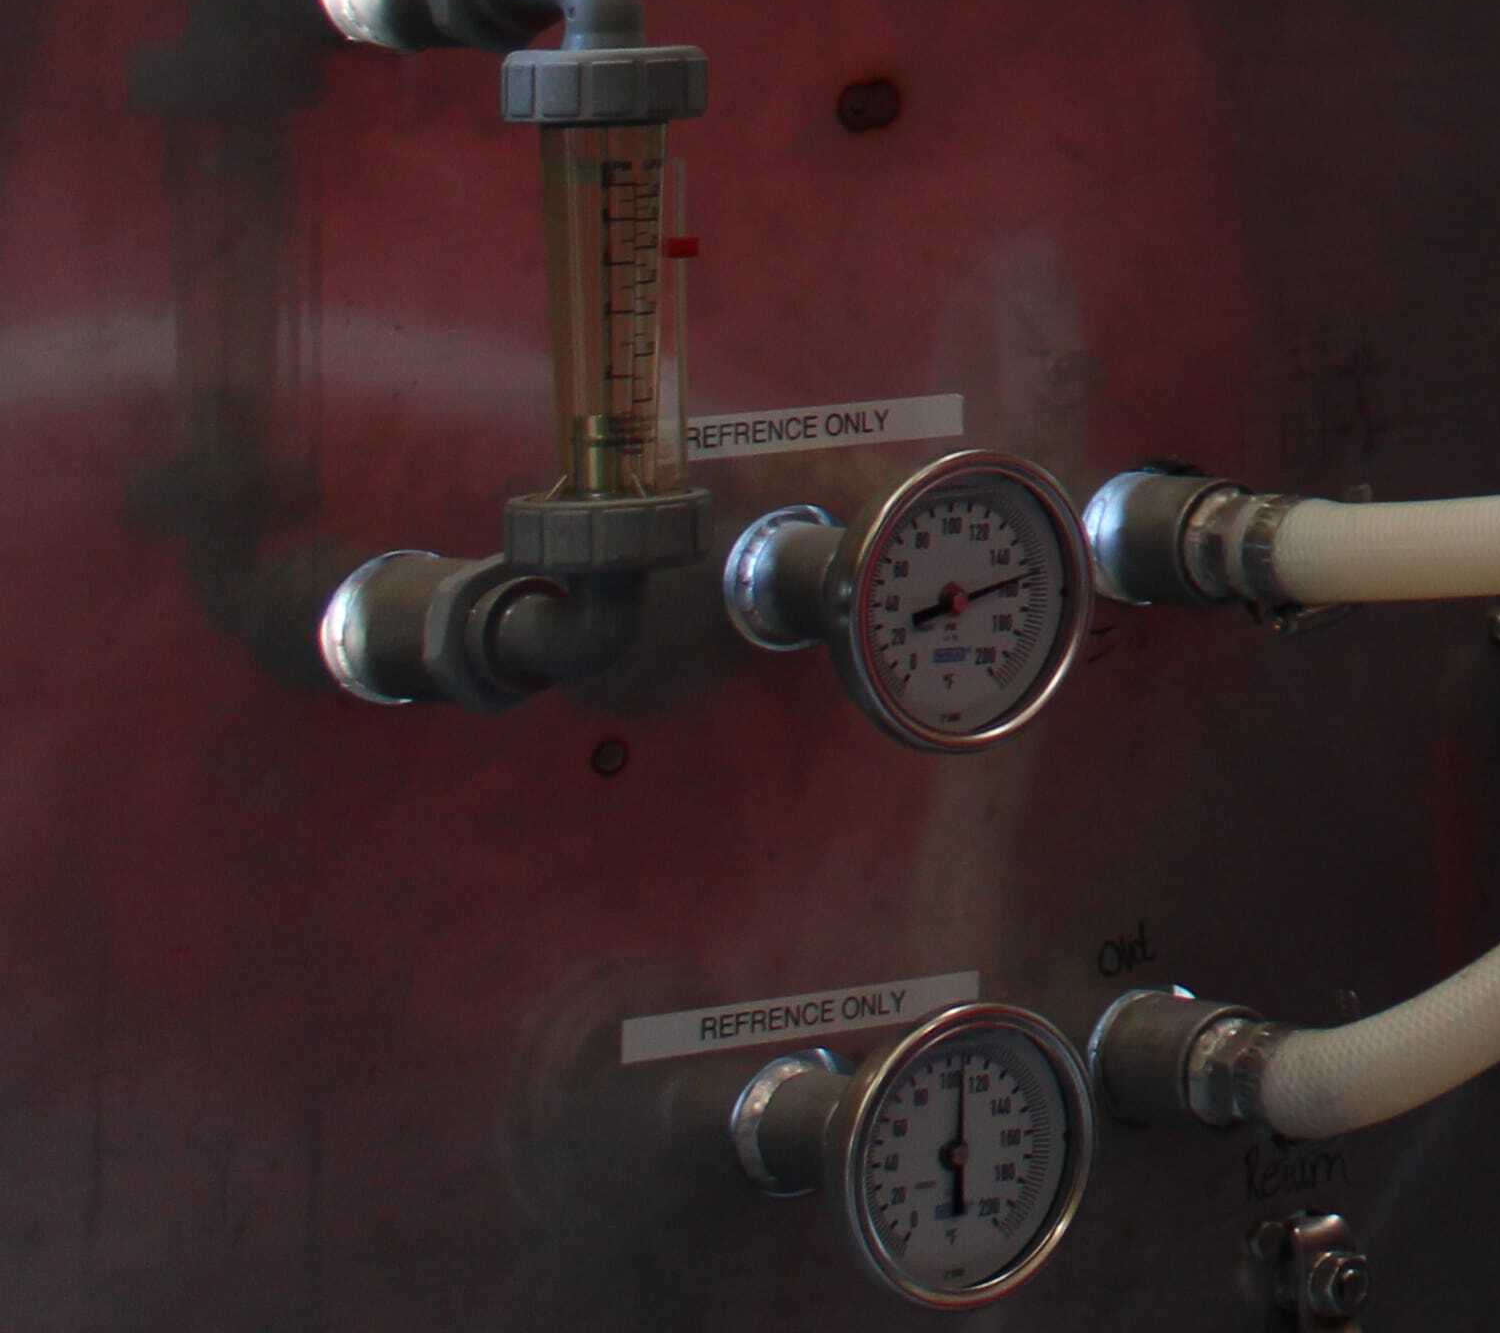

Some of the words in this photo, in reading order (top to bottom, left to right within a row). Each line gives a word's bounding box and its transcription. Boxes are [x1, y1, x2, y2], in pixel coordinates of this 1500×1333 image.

[687, 415, 818, 449] REFRENCE
[825, 409, 889, 438] ONLY
[700, 997, 833, 1041] REFRENCE
[840, 990, 907, 1020] ONLY
